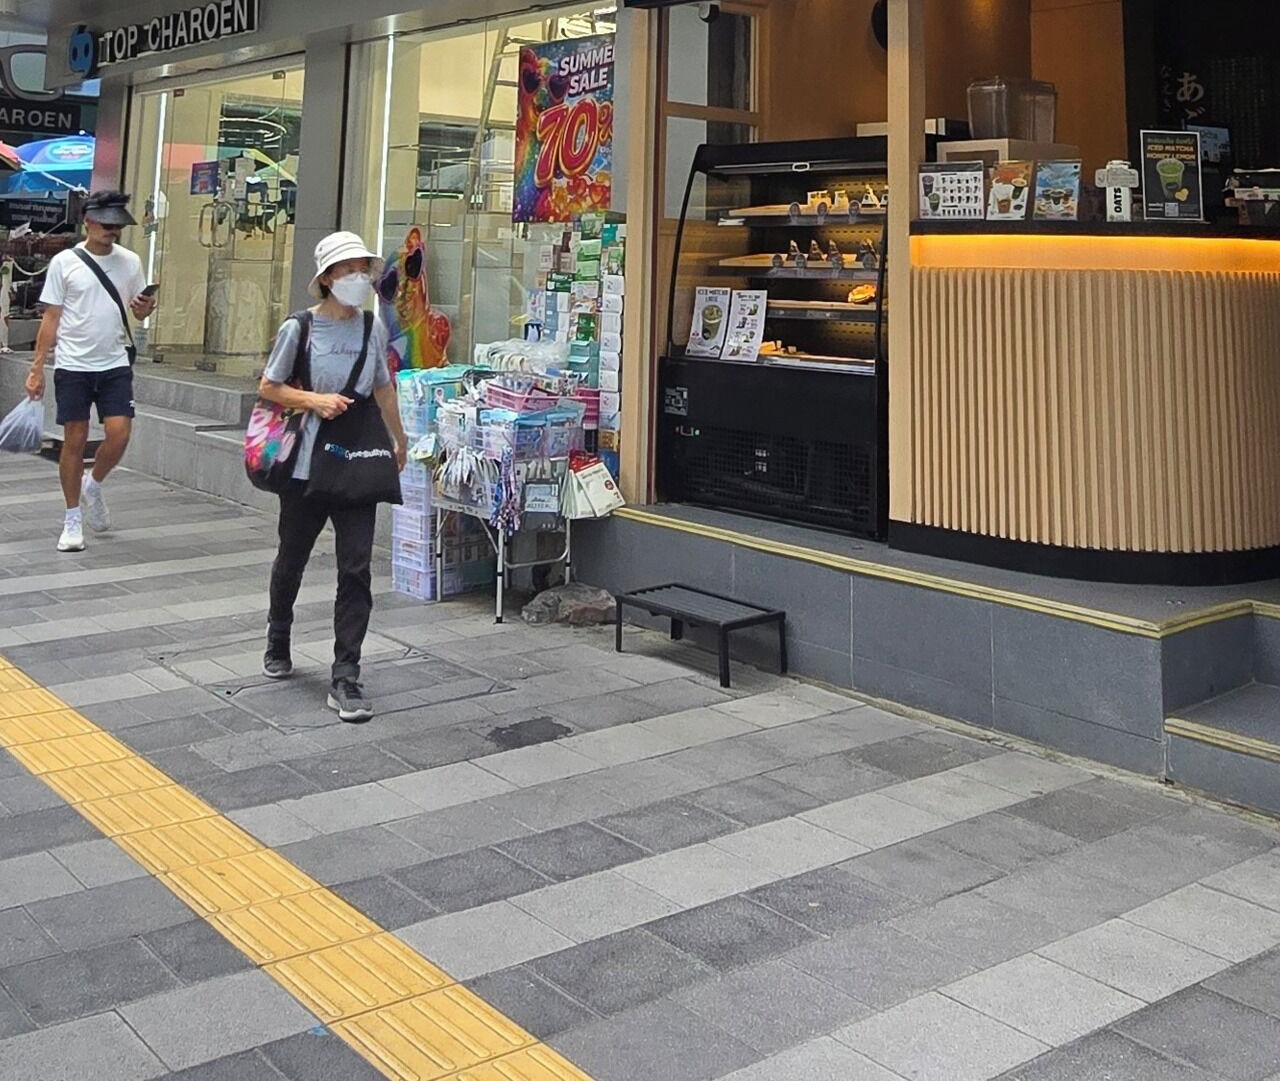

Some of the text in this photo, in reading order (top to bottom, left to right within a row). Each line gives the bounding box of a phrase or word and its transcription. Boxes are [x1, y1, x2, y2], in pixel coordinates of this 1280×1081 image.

[104, 25, 139, 63] TOP
[559, 44, 616, 75] SUMME
[568, 66, 609, 95] SALE
[1114, 186, 1124, 213] OATS
